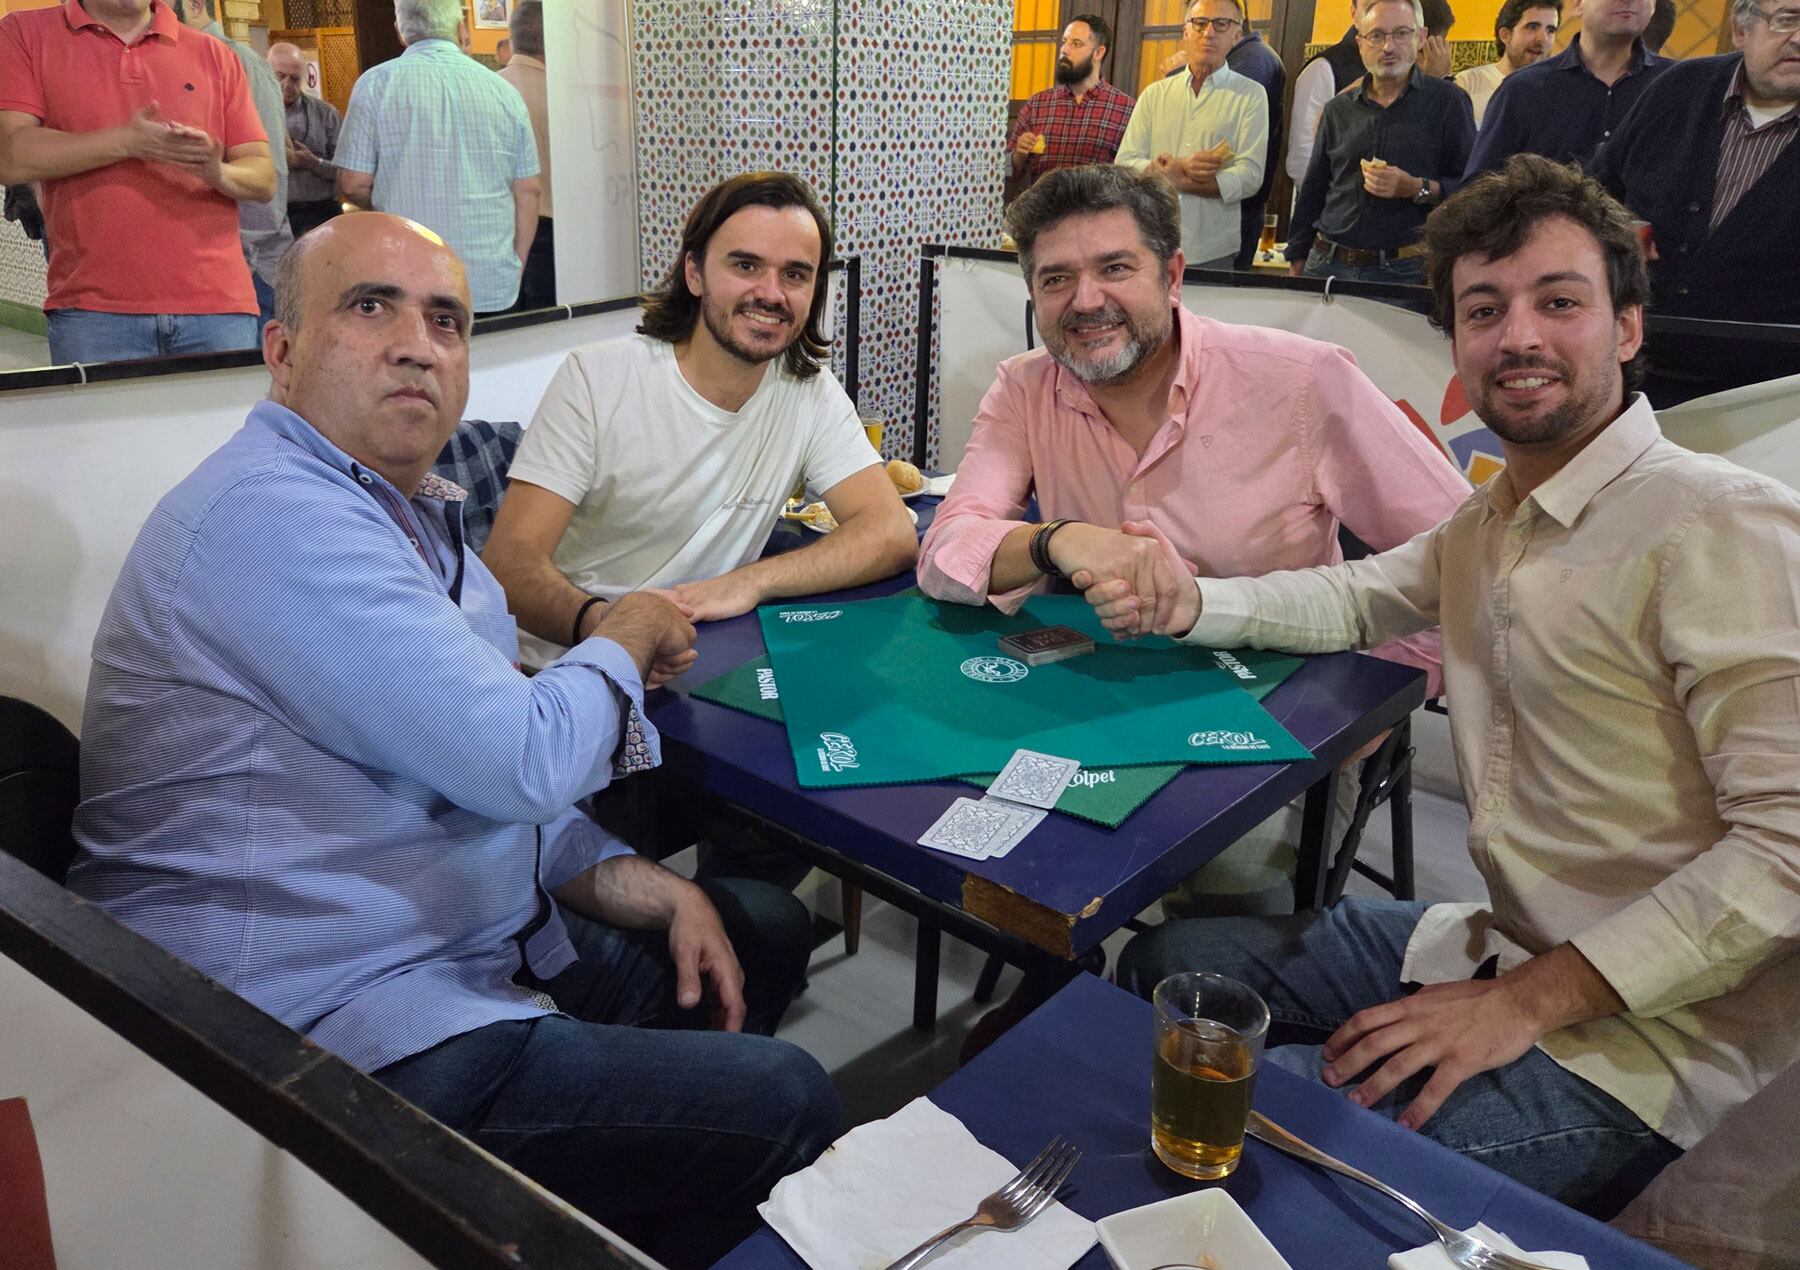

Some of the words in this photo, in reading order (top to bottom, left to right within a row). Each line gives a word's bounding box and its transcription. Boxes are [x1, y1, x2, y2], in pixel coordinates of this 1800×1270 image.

[1213, 651, 1257, 679] PASTOR
[756, 668, 779, 700] PASTOR
[820, 732, 860, 772] CEROL
[1187, 730, 1267, 746] CEROL
[1068, 769, 1116, 789] olpet
